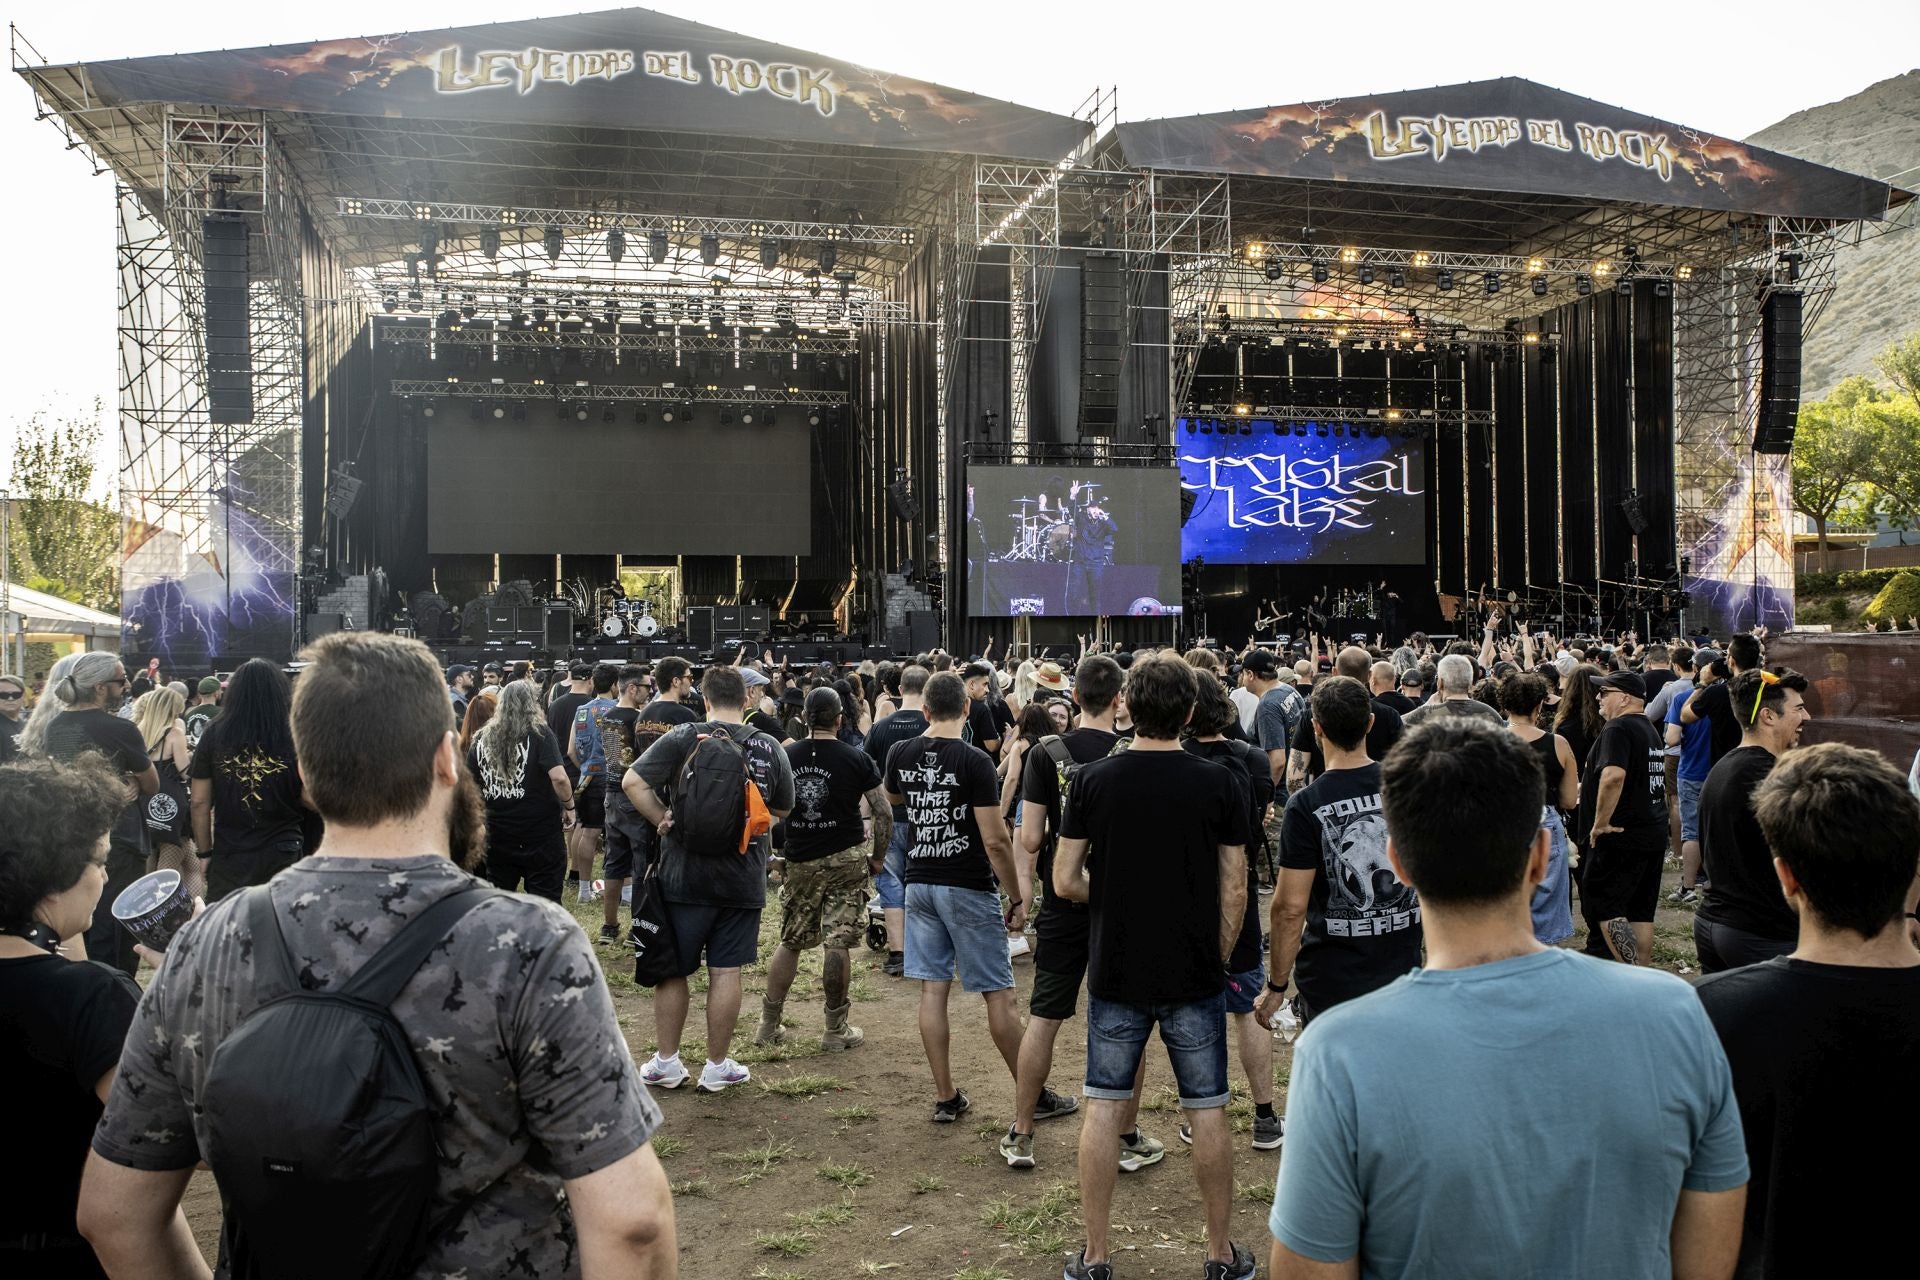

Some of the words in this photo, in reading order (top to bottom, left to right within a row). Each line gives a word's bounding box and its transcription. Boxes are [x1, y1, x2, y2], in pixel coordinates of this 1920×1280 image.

[437, 45, 633, 94] LEYENDAS
[647, 51, 700, 82] DEL
[711, 54, 834, 116] ROCK
[1367, 111, 1521, 161] LEYENDAS
[1527, 120, 1571, 150] DEL
[1576, 123, 1671, 181] ROCK
[906, 790, 951, 808] THREE
[1312, 793, 1384, 824] POW
[906, 808, 950, 825] ECADES
[953, 804, 968, 821] OF
[916, 823, 959, 842] METAL
[1362, 910, 1377, 918] OF
[1380, 906, 1399, 915] THE
